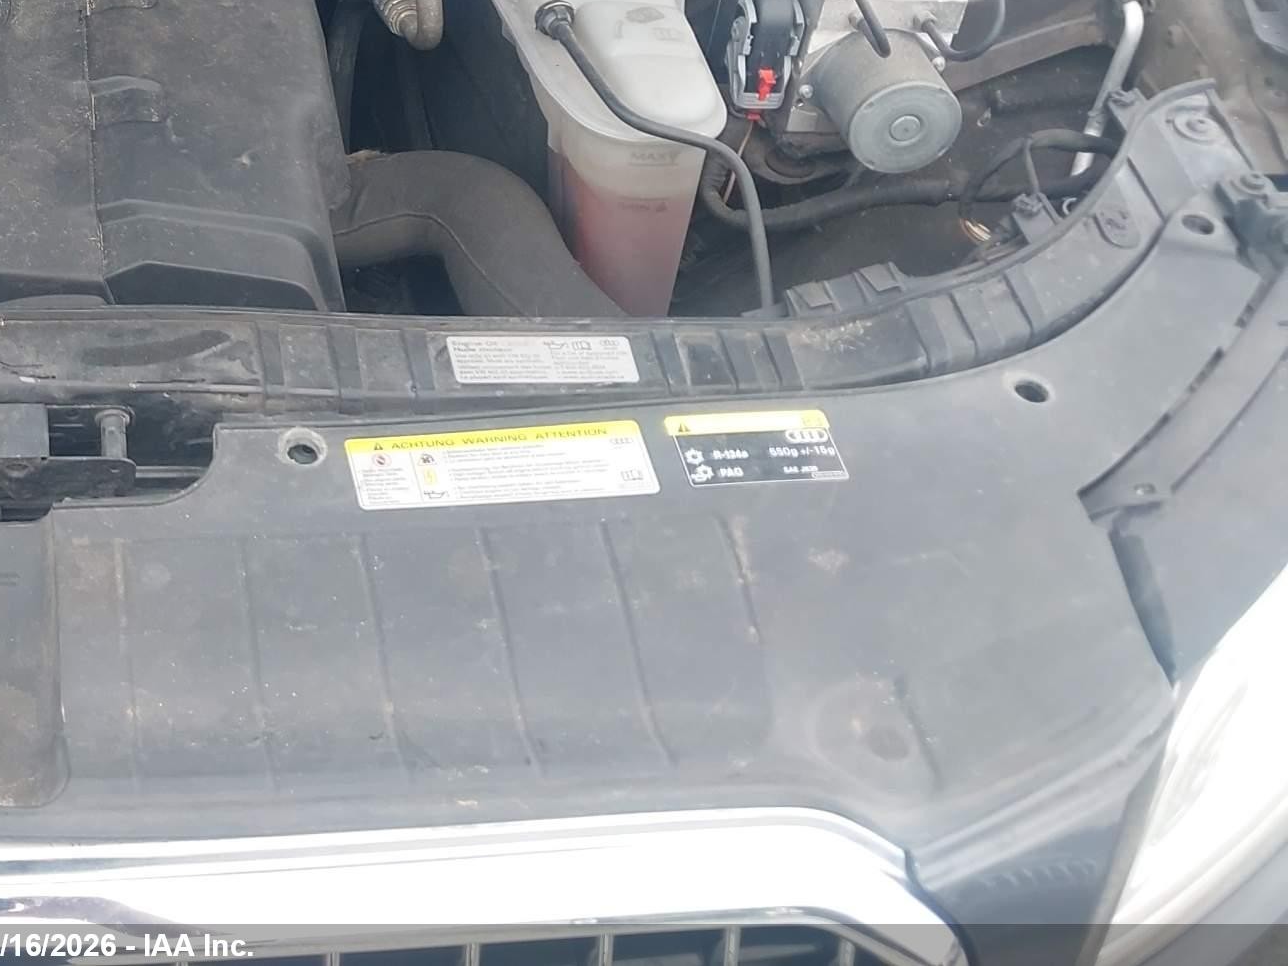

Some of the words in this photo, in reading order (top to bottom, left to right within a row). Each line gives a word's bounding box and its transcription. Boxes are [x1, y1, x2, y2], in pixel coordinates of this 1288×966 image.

[391, 438, 455, 450] ACHTUNG
[462, 432, 528, 445] WARNING
[535, 427, 608, 440] ATTENTION
